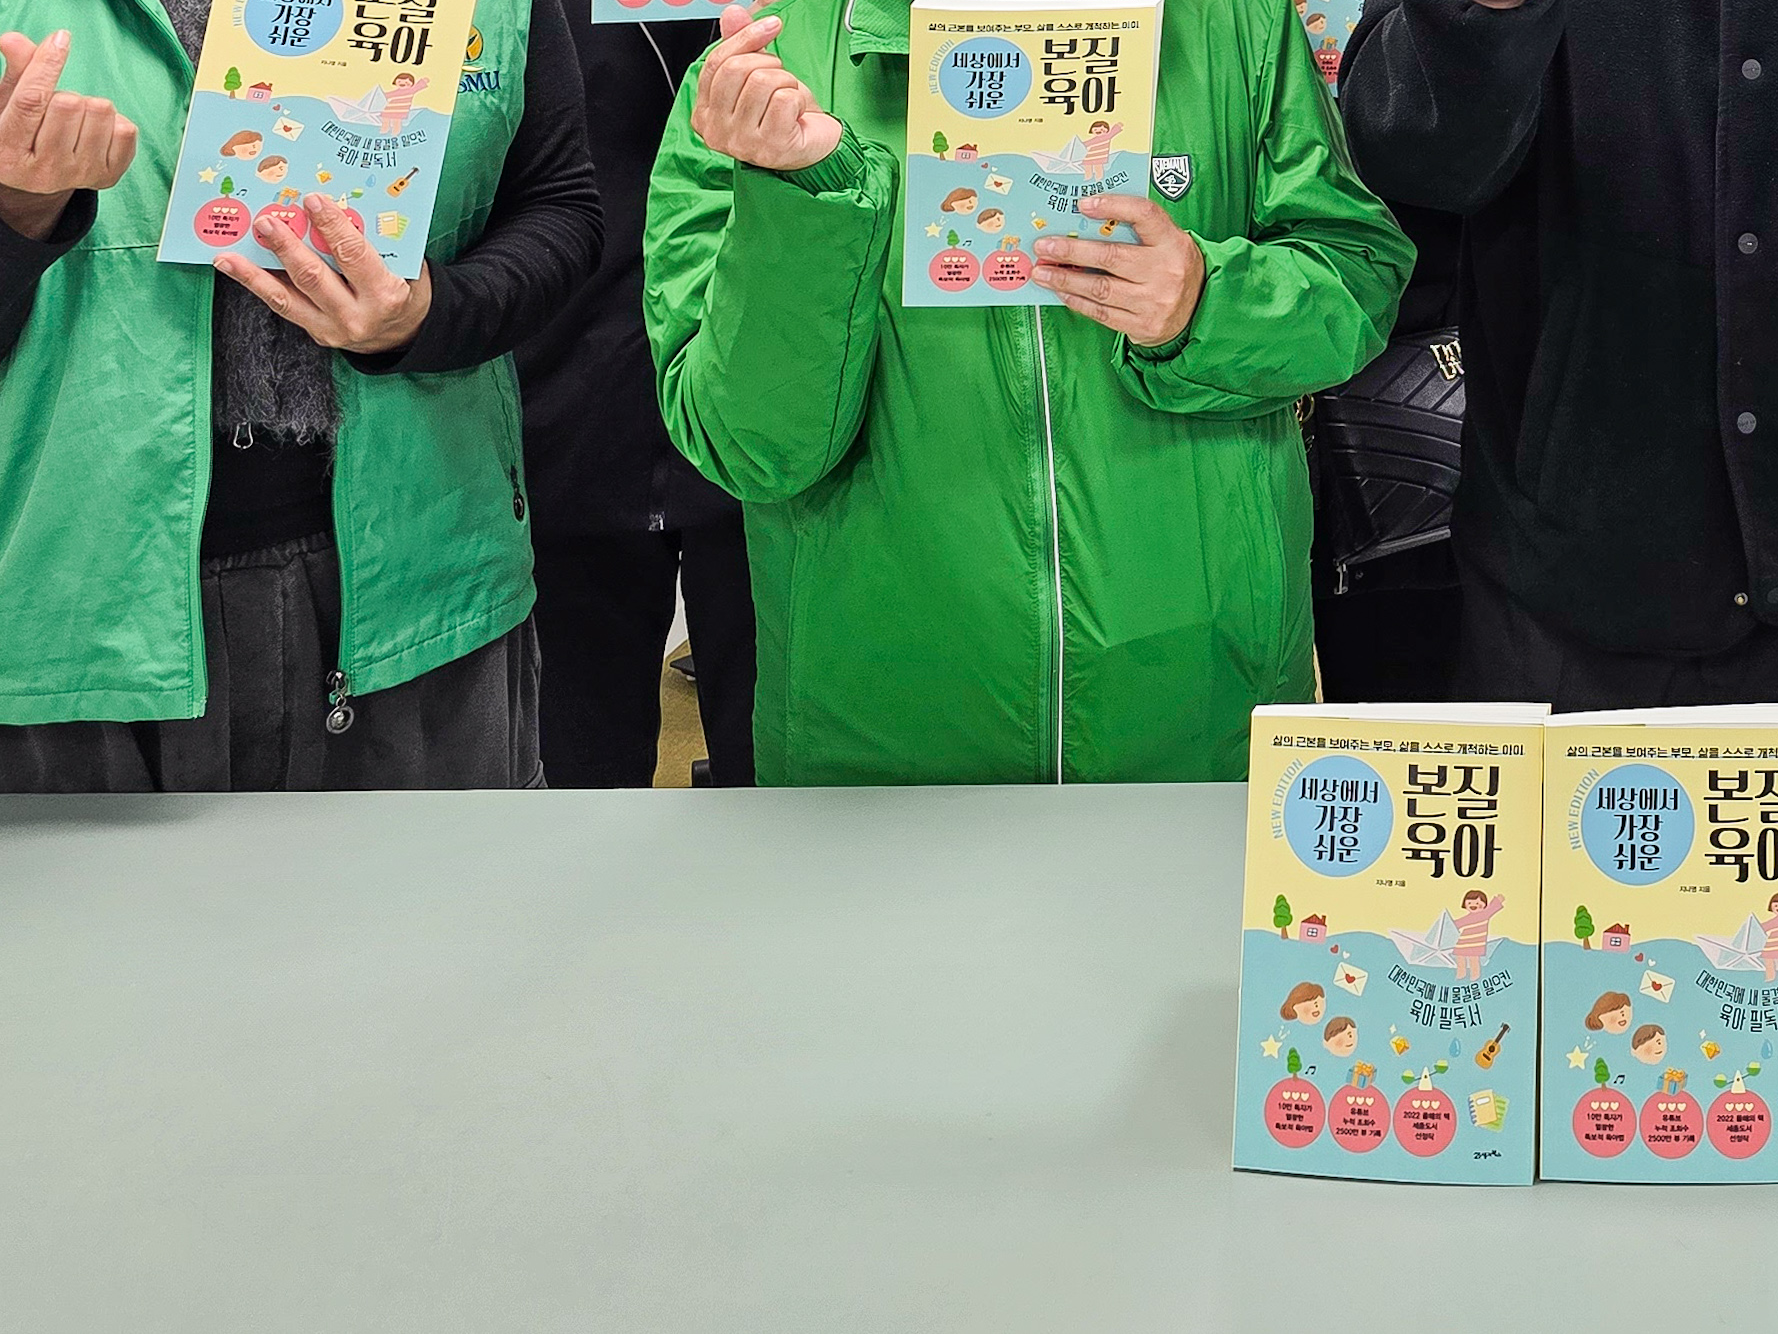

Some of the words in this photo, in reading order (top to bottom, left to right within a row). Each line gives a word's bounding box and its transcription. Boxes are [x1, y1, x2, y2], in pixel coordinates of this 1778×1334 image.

[271, 4, 318, 27] 가장
[268, 25, 310, 48] 쉬운
[347, 21, 432, 64] 육아
[952, 52, 1020, 68] 세상에서
[1040, 37, 1120, 75] 본질
[965, 70, 1007, 89] 가장
[965, 90, 1004, 108] 쉬운
[1040, 77, 1121, 115] 육아
[1299, 778, 1379, 803] 세상에서
[1403, 762, 1498, 819] 본질
[1596, 788, 1678, 811] 세상에서
[1314, 805, 1363, 834] 가장
[1613, 814, 1663, 842] 가장
[1313, 835, 1360, 863] 쉬운
[1402, 821, 1501, 878] 육아
[1613, 844, 1662, 870] 쉬운
[1411, 1000, 1436, 1027] 육아
[1440, 1003, 1481, 1030] 필독서
[1720, 1004, 1746, 1030] 육아
